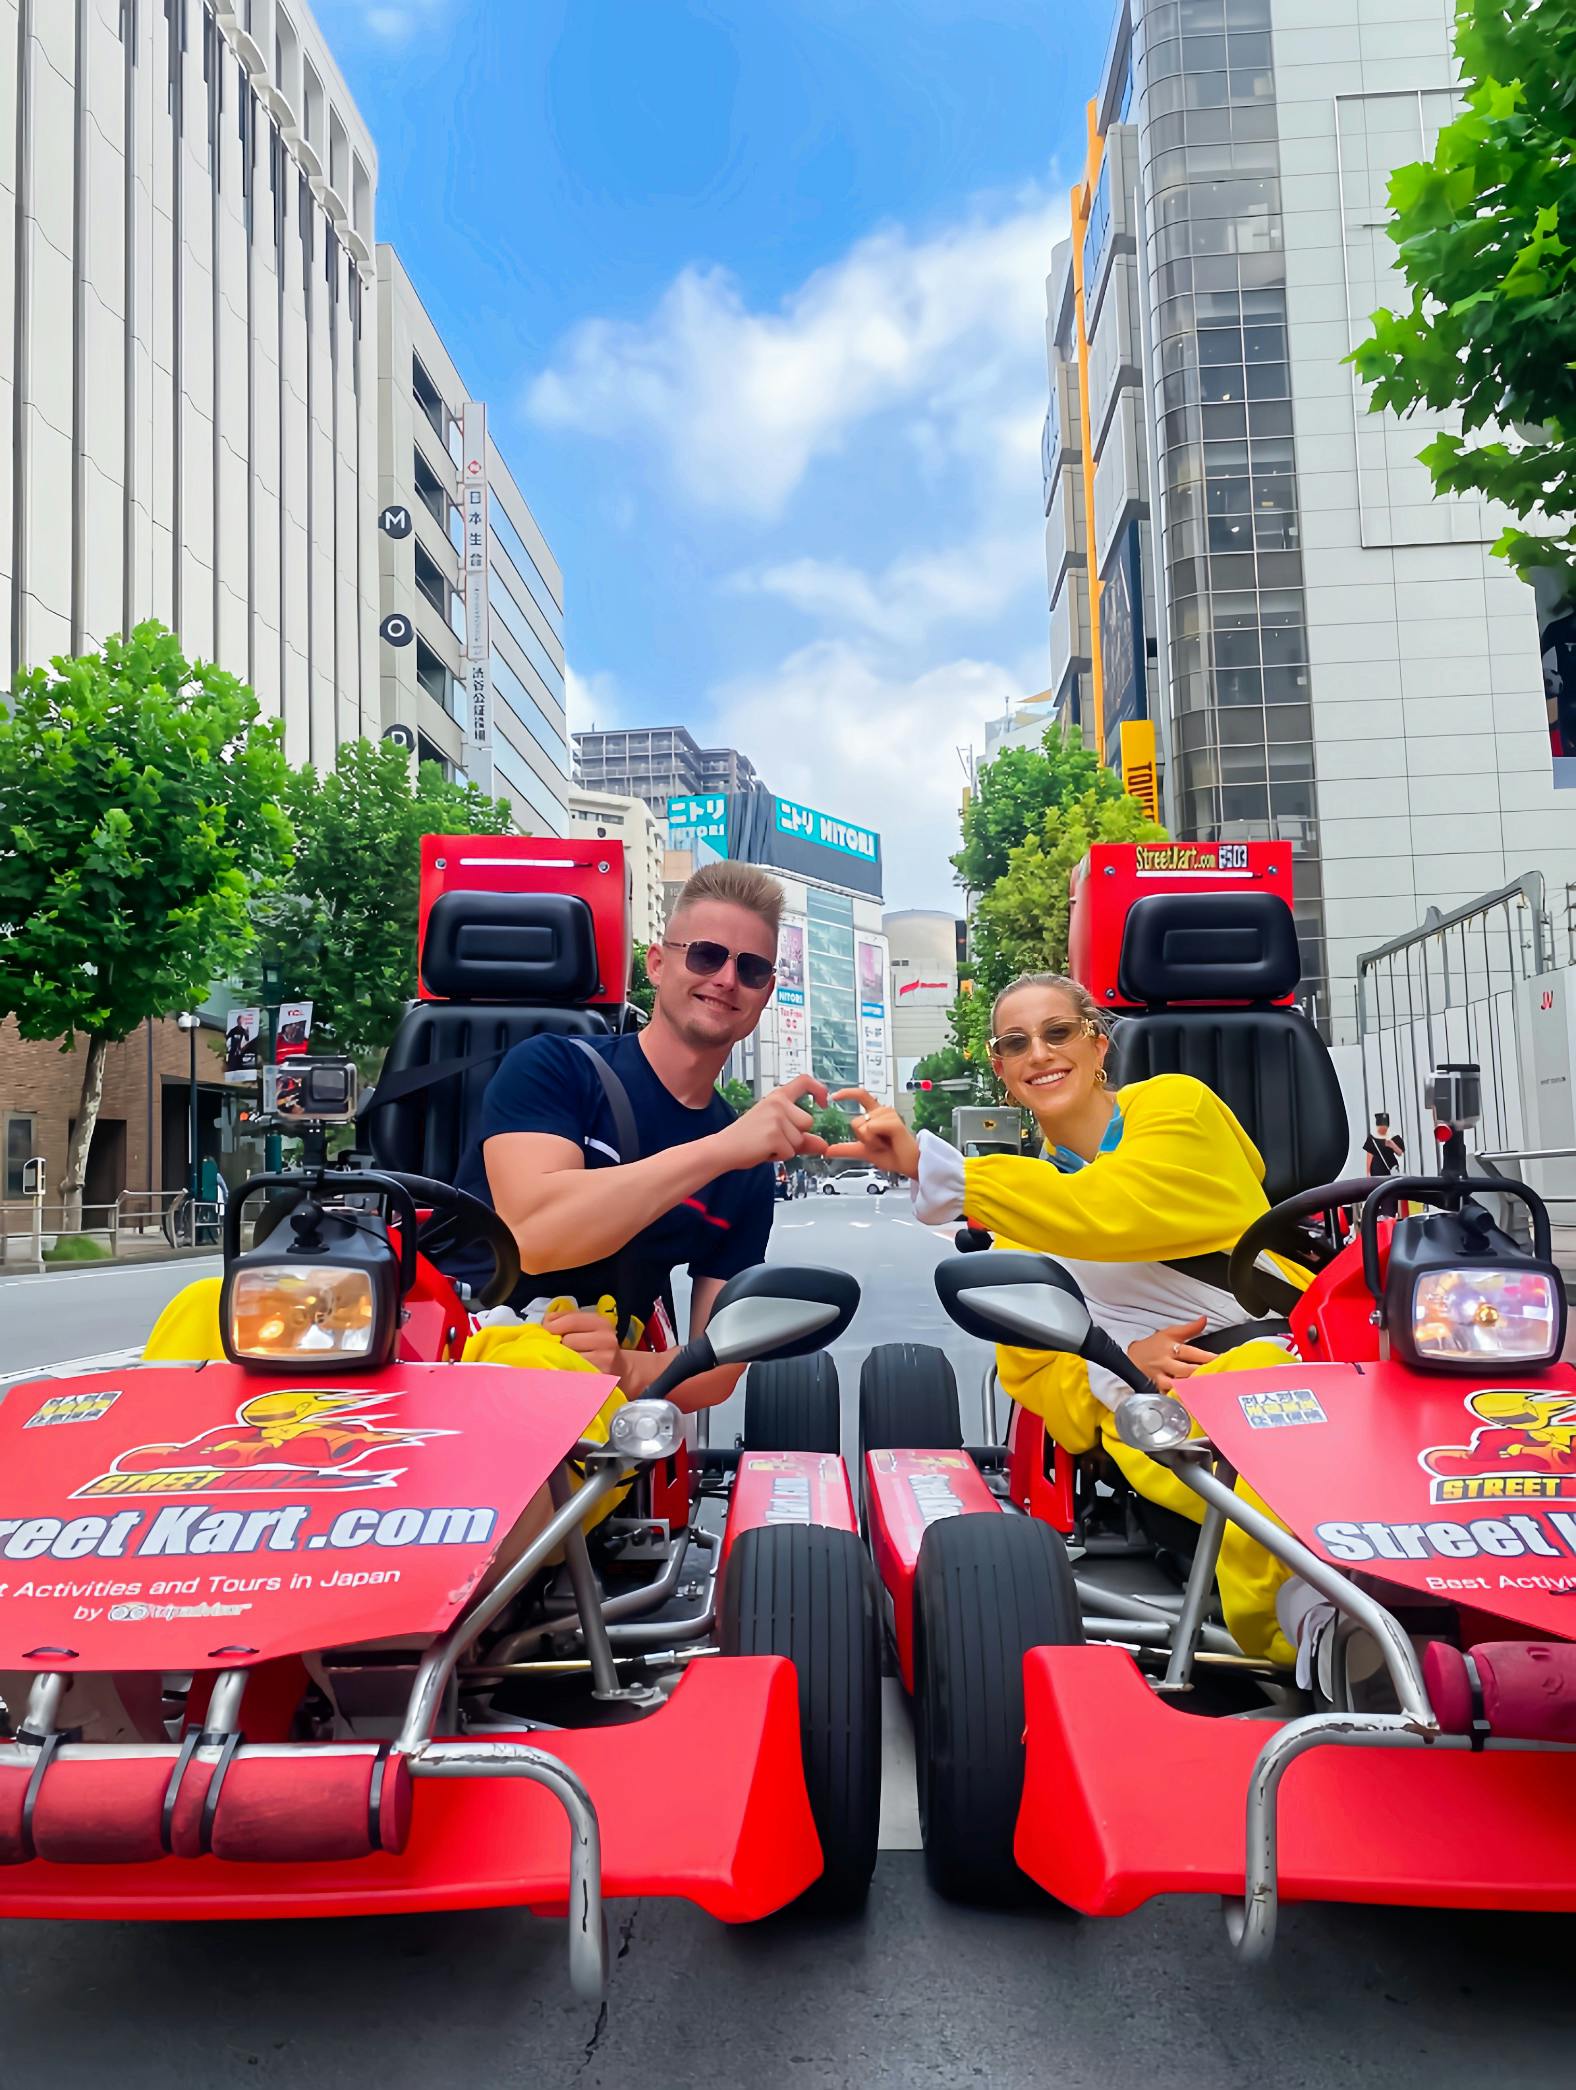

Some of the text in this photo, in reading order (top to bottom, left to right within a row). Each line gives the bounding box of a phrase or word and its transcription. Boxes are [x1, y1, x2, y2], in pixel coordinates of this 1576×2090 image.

[384, 511, 406, 530] M
[387, 619, 405, 638] O
[669, 799, 725, 824] ニトリ
[781, 802, 813, 835] ニトリ
[820, 816, 875, 857] NITORI
[778, 990, 803, 1004] NITORI
[91, 1471, 224, 1493] STREET
[1442, 1478, 1560, 1499] STREET
[1317, 1515, 1561, 1560] Street
[13, 1579, 141, 1597] Activities
[149, 1577, 201, 1595] and
[208, 1575, 281, 1594] Tours
[290, 1573, 312, 1590] in
[320, 1570, 401, 1588] Japan
[1425, 1577, 1492, 1590] Best
[73, 1605, 104, 1621] by
